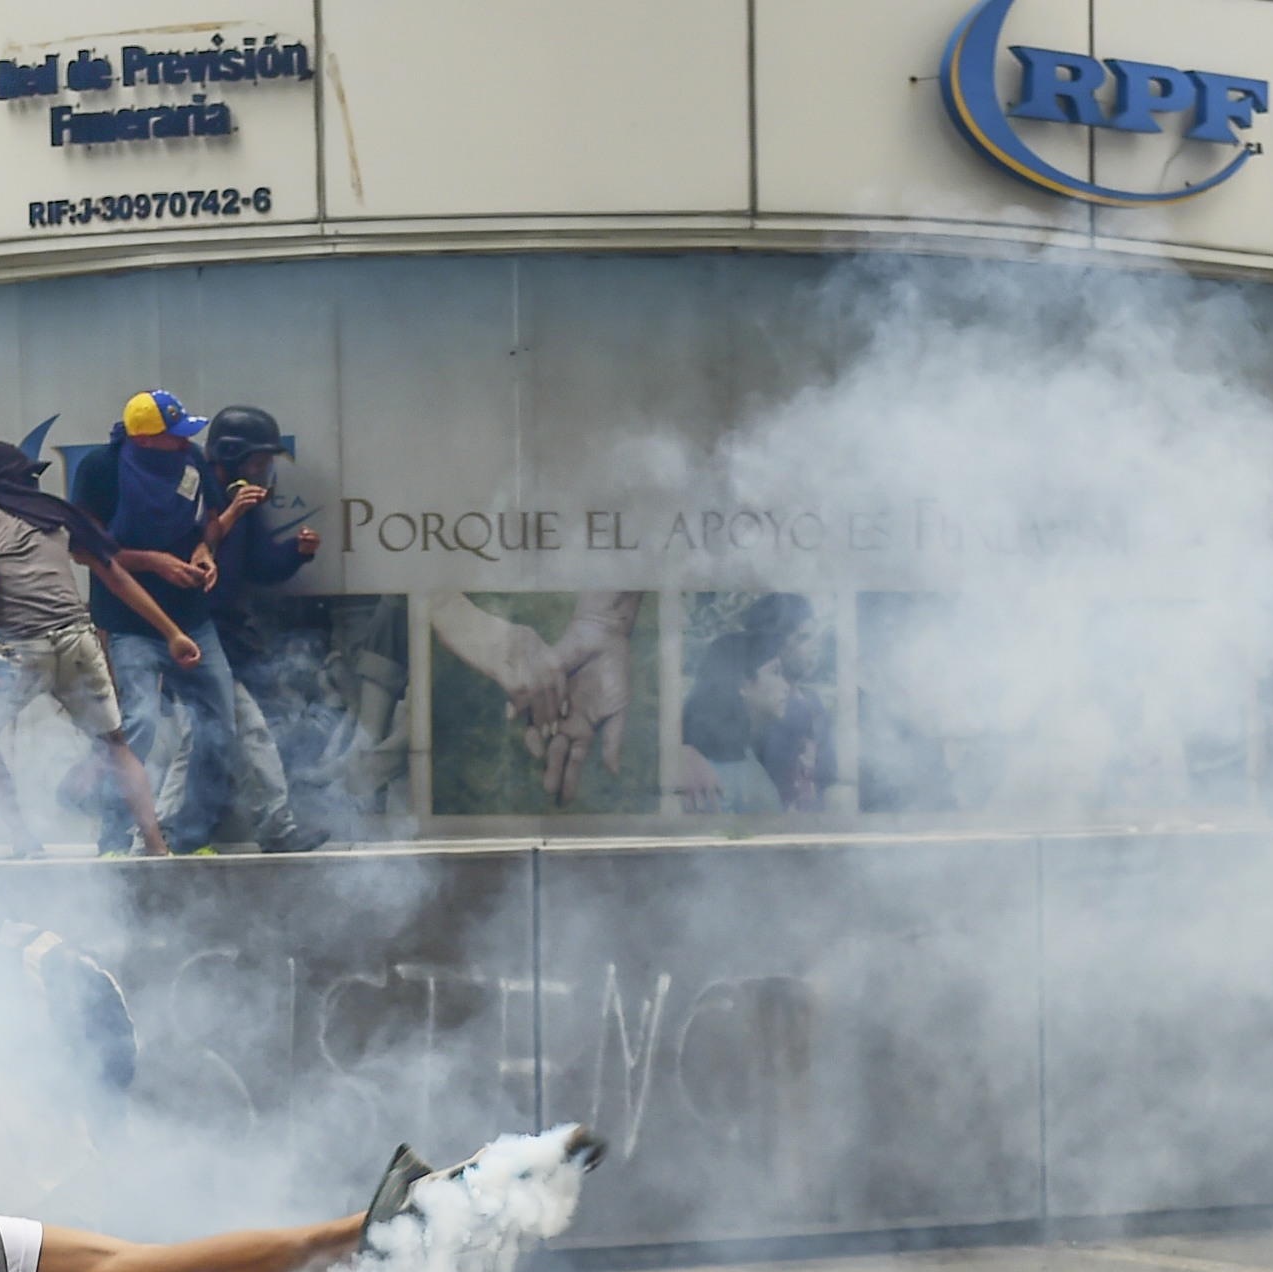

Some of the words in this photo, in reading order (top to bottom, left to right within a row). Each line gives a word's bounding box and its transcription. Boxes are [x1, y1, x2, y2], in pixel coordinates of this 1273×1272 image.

[67, 49, 113, 91] de
[1006, 45, 1268, 147] RPF
[340, 498, 561, 562] PORQUE
[585, 510, 639, 551] EL
[664, 510, 824, 553] APOYO
